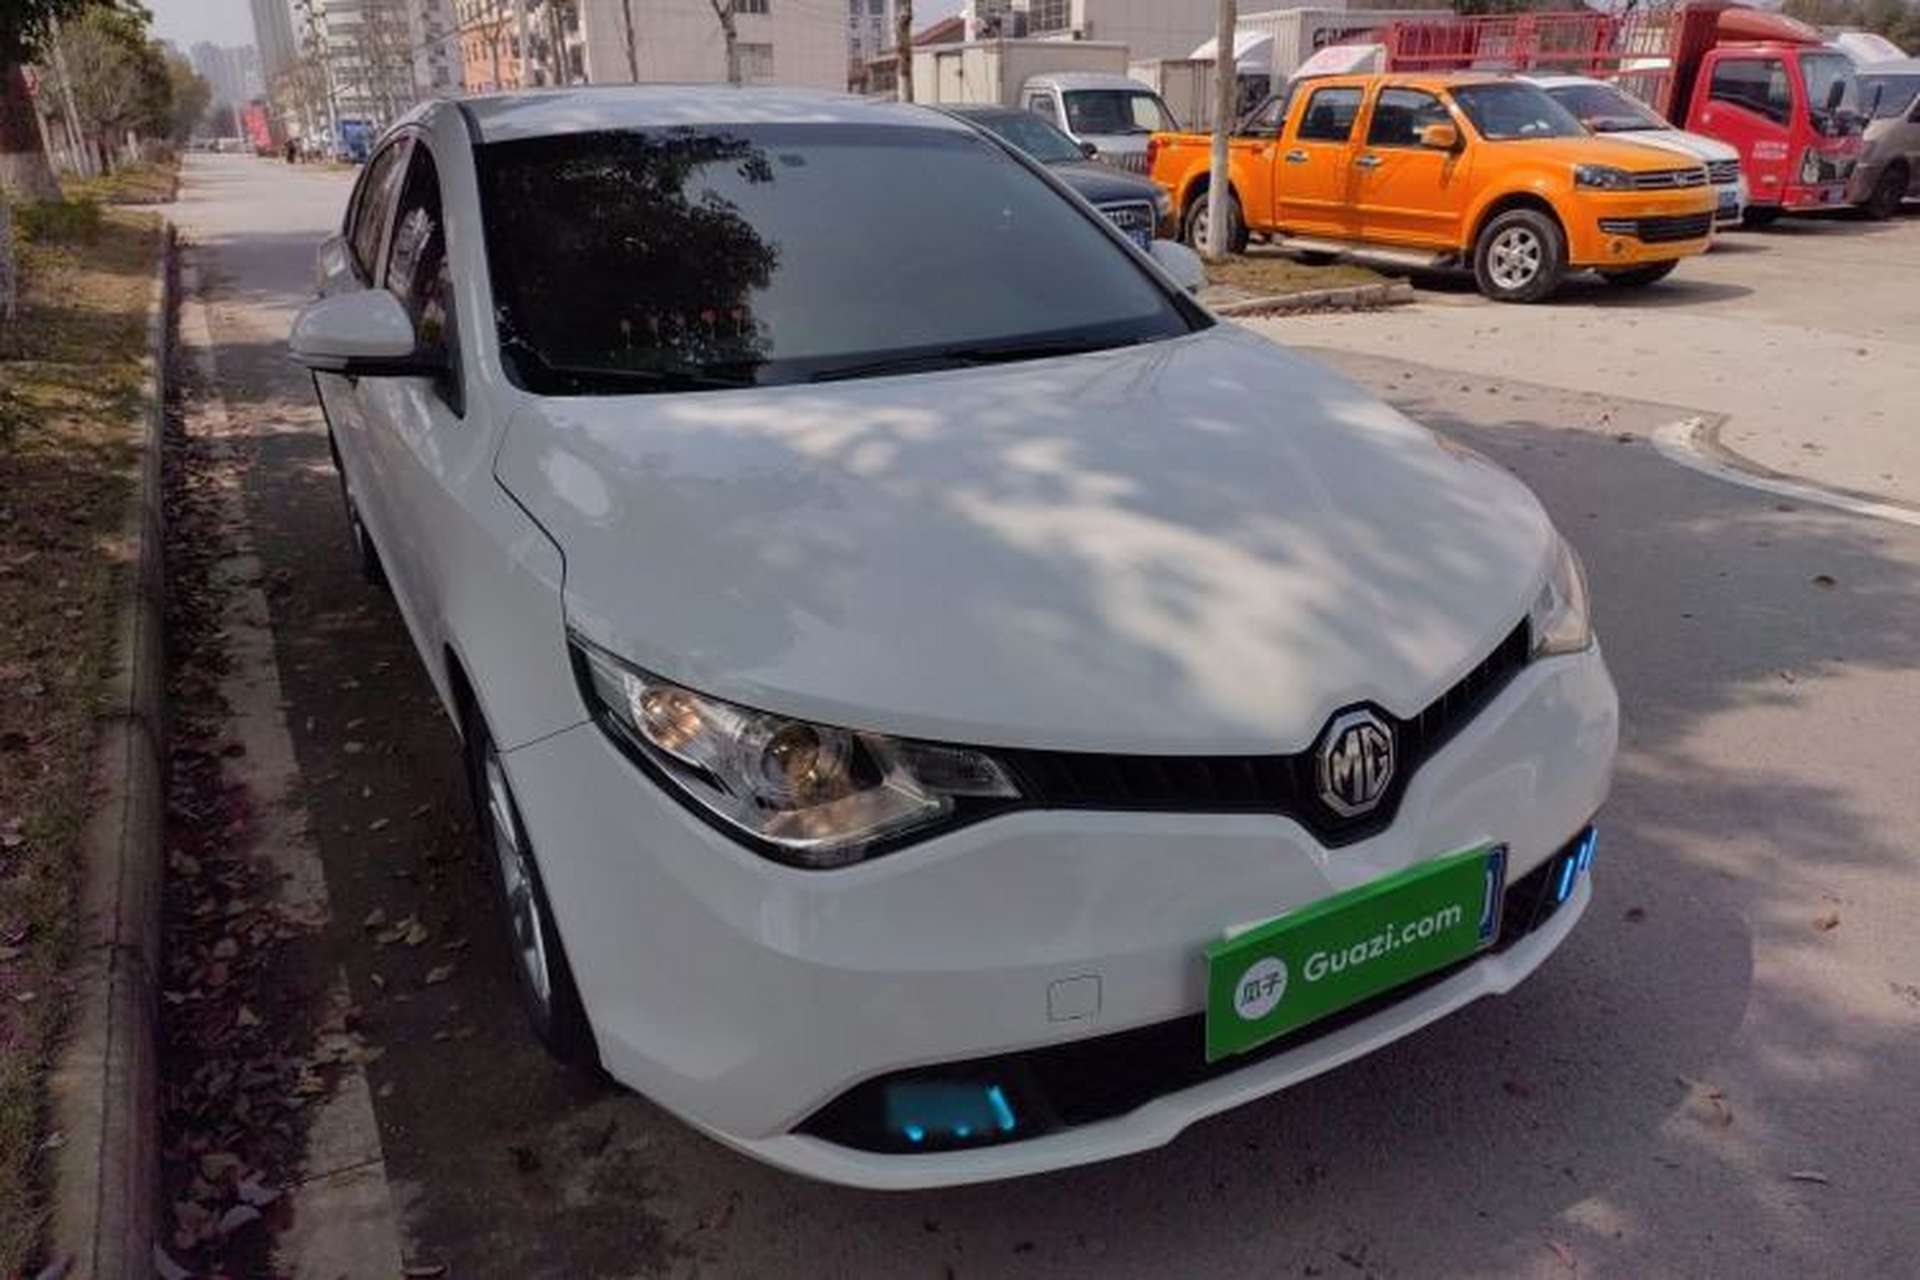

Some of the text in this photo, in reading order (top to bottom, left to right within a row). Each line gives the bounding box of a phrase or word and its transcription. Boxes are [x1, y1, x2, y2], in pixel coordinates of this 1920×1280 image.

[1332, 726, 1388, 801] MG
[1303, 904, 1462, 982] Guazi.com
[1240, 971, 1281, 1007] 瓜子
